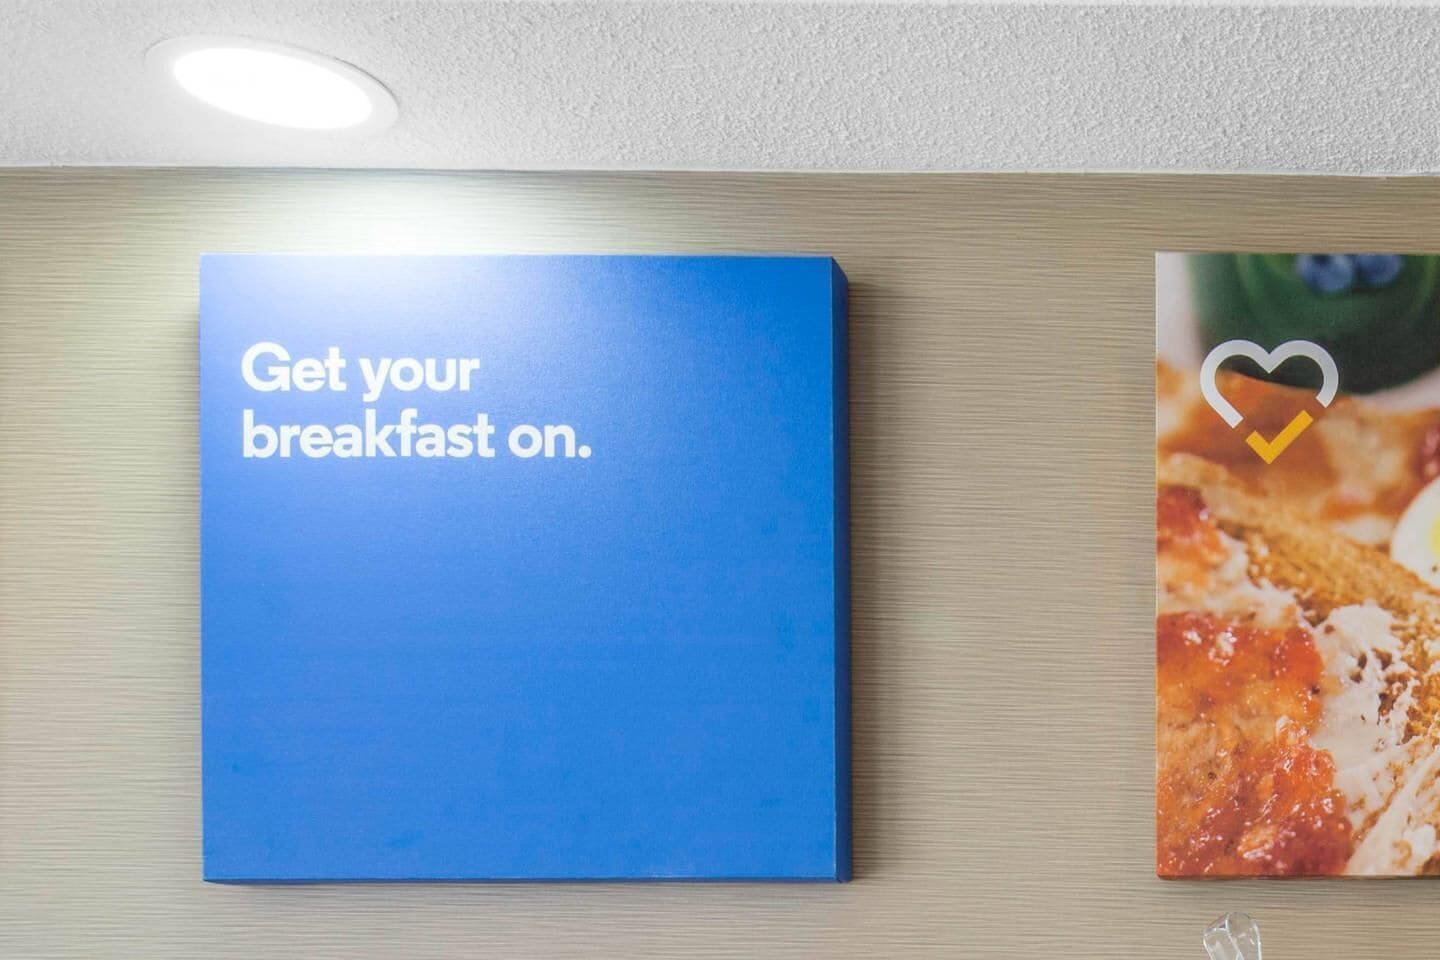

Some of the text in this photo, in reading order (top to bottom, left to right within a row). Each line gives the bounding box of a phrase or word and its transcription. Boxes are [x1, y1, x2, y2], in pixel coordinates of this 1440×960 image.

[241, 341, 481, 402] Get your
[243, 408, 592, 458] breakfast on.
